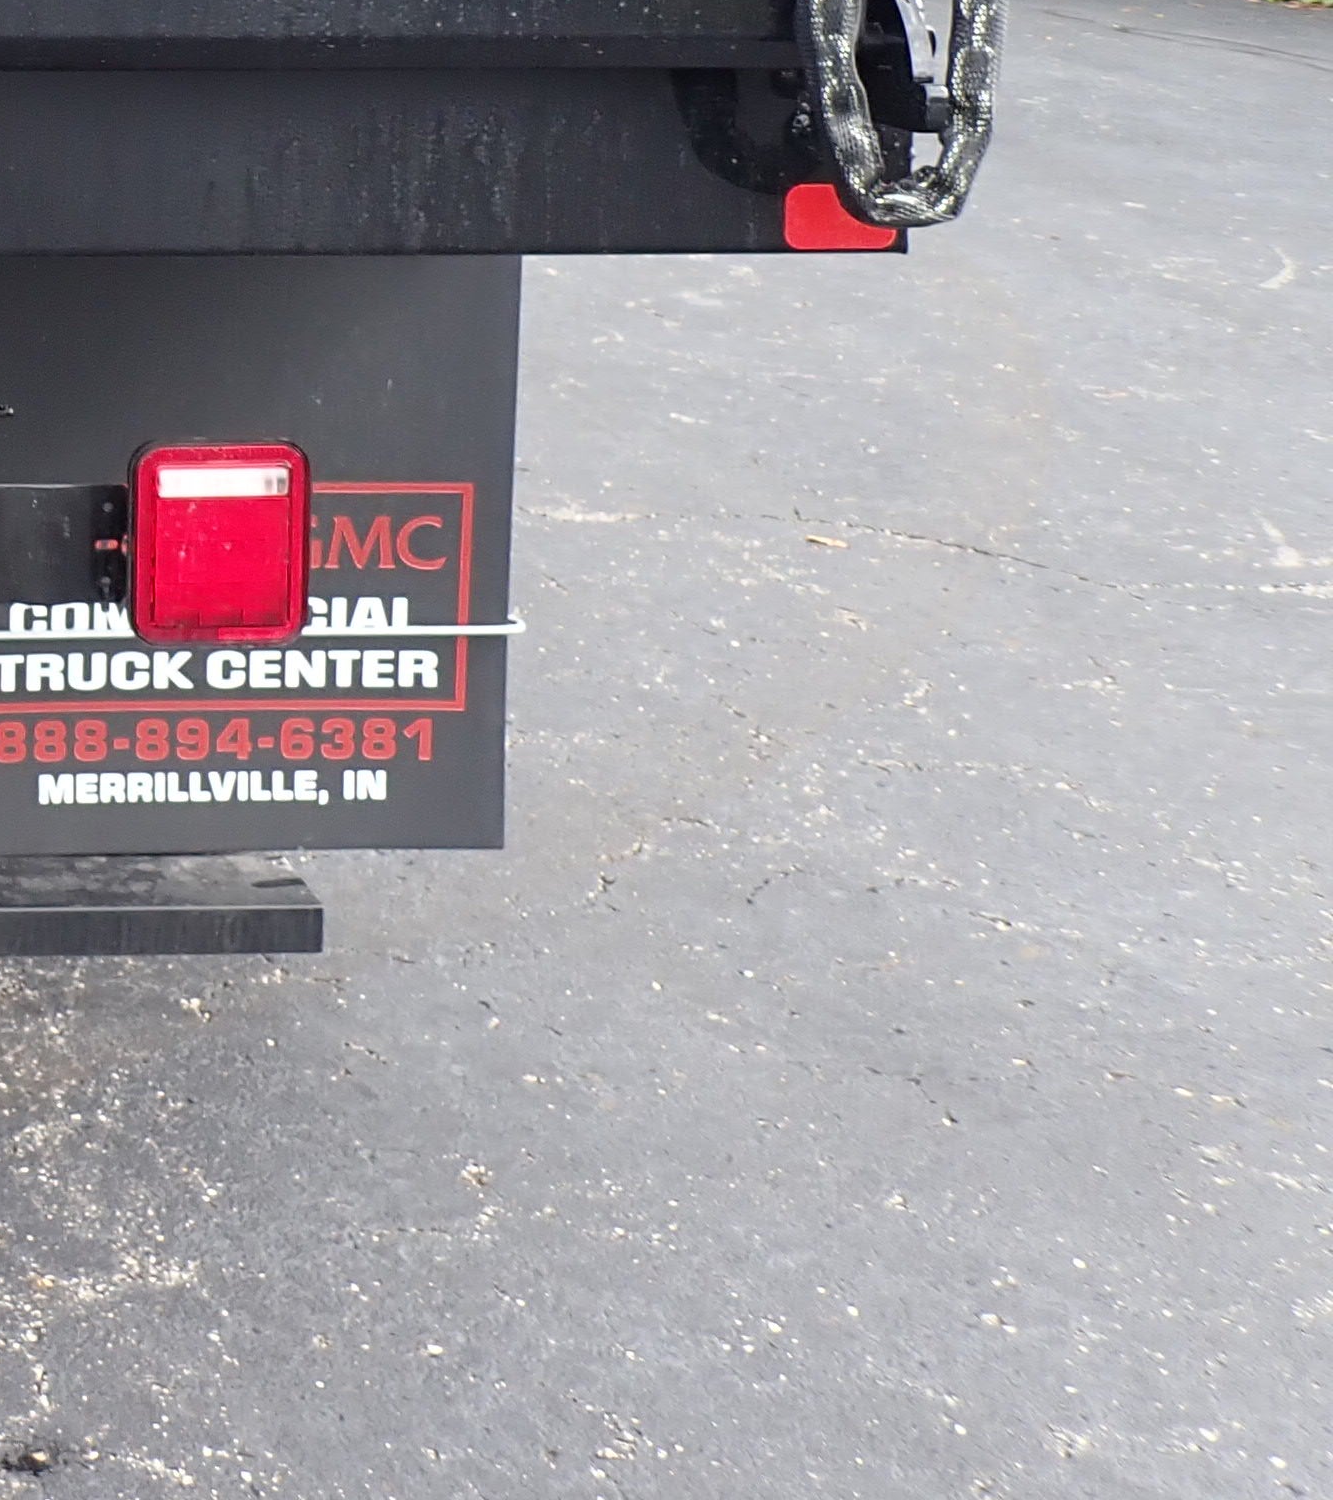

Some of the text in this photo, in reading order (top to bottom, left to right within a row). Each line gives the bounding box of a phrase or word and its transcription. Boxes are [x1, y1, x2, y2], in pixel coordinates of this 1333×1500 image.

[310, 515, 447, 570] MC
[206, 649, 439, 688] CENTER
[38, 769, 387, 806] MERRILLVILLE, IN
